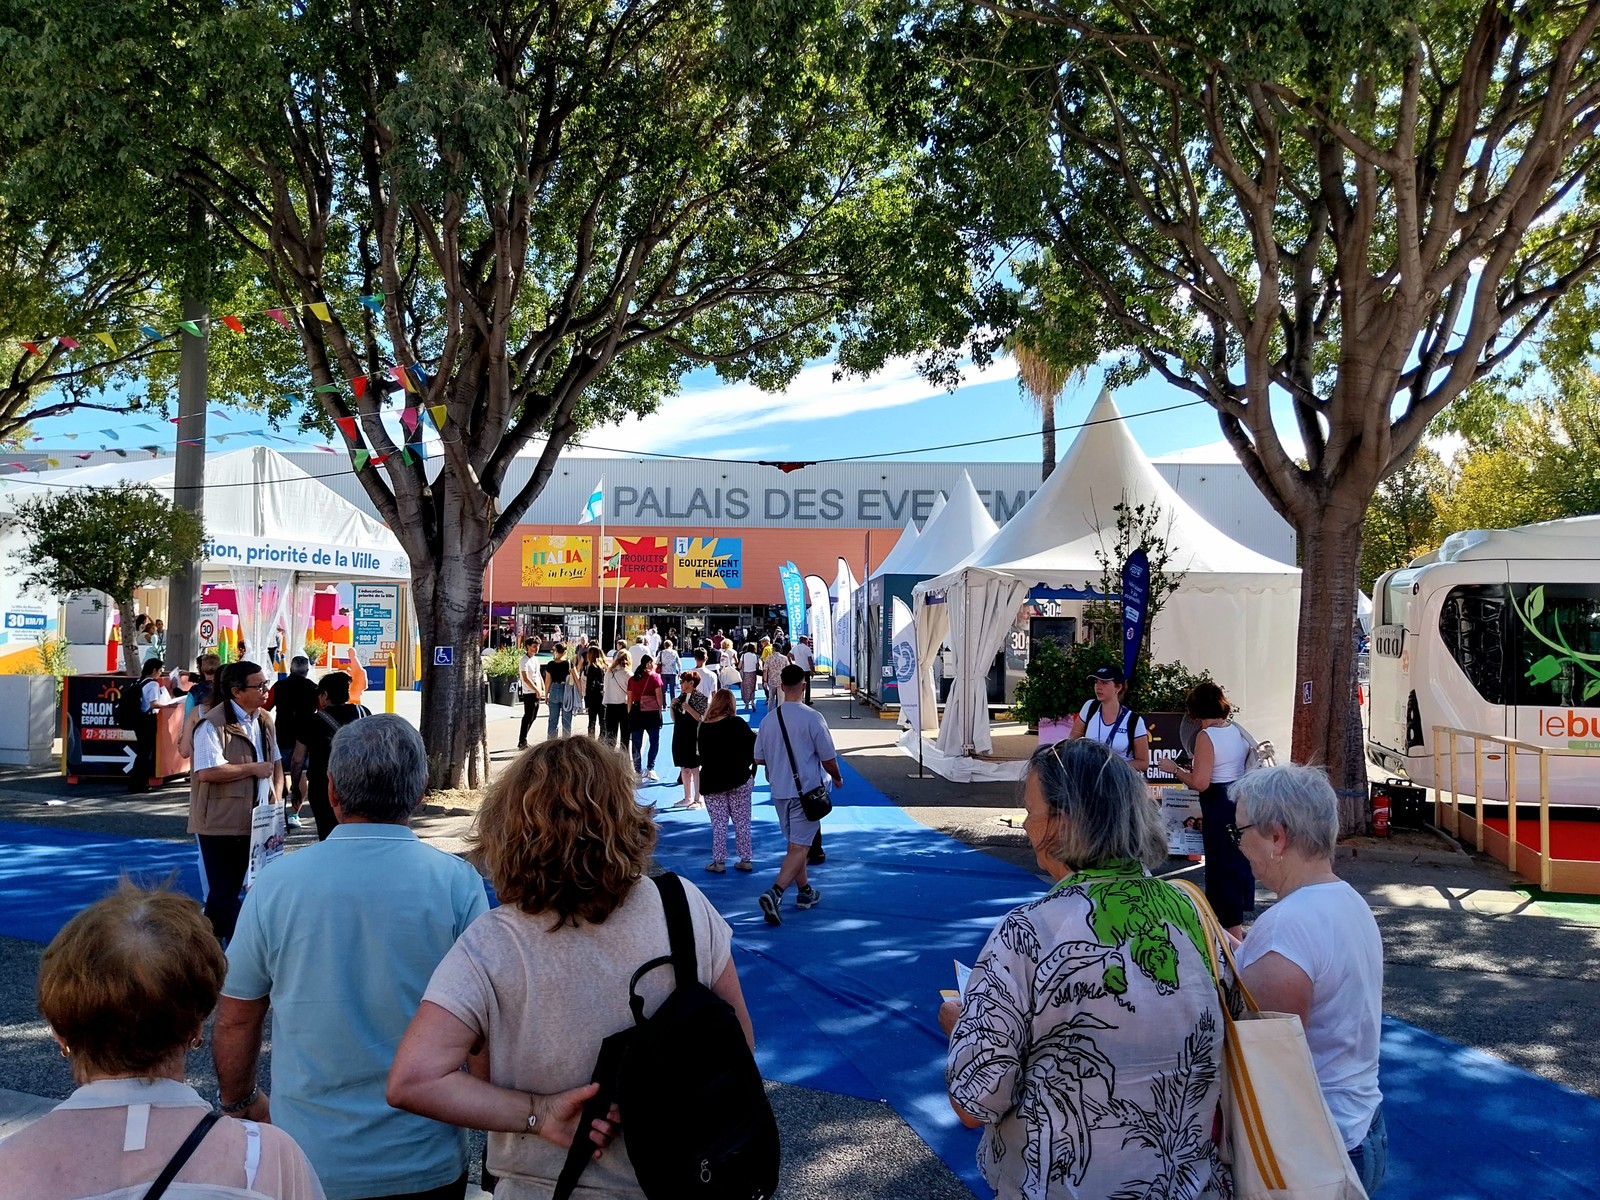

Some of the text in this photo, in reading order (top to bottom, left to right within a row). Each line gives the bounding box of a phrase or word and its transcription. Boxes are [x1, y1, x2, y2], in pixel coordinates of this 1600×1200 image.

[614, 486, 750, 519] PALAIS
[764, 488, 844, 520] DES
[678, 543, 686, 554] 1
[246, 543, 307, 564] priorité
[312, 548, 331, 565] de
[335, 550, 348, 567] la
[352, 551, 381, 570] Ville
[623, 564, 665, 573] TERROIR
[1043, 602, 1056, 617] 30
[8, 614, 25, 627] 30
[202, 624, 211, 634] 30
[1011, 632, 1026, 650] 30
[81, 702, 113, 715] SALON
[81, 716, 115, 725] ESPORT &
[86, 729, 93, 739] 27
[98, 730, 106, 739] 29
